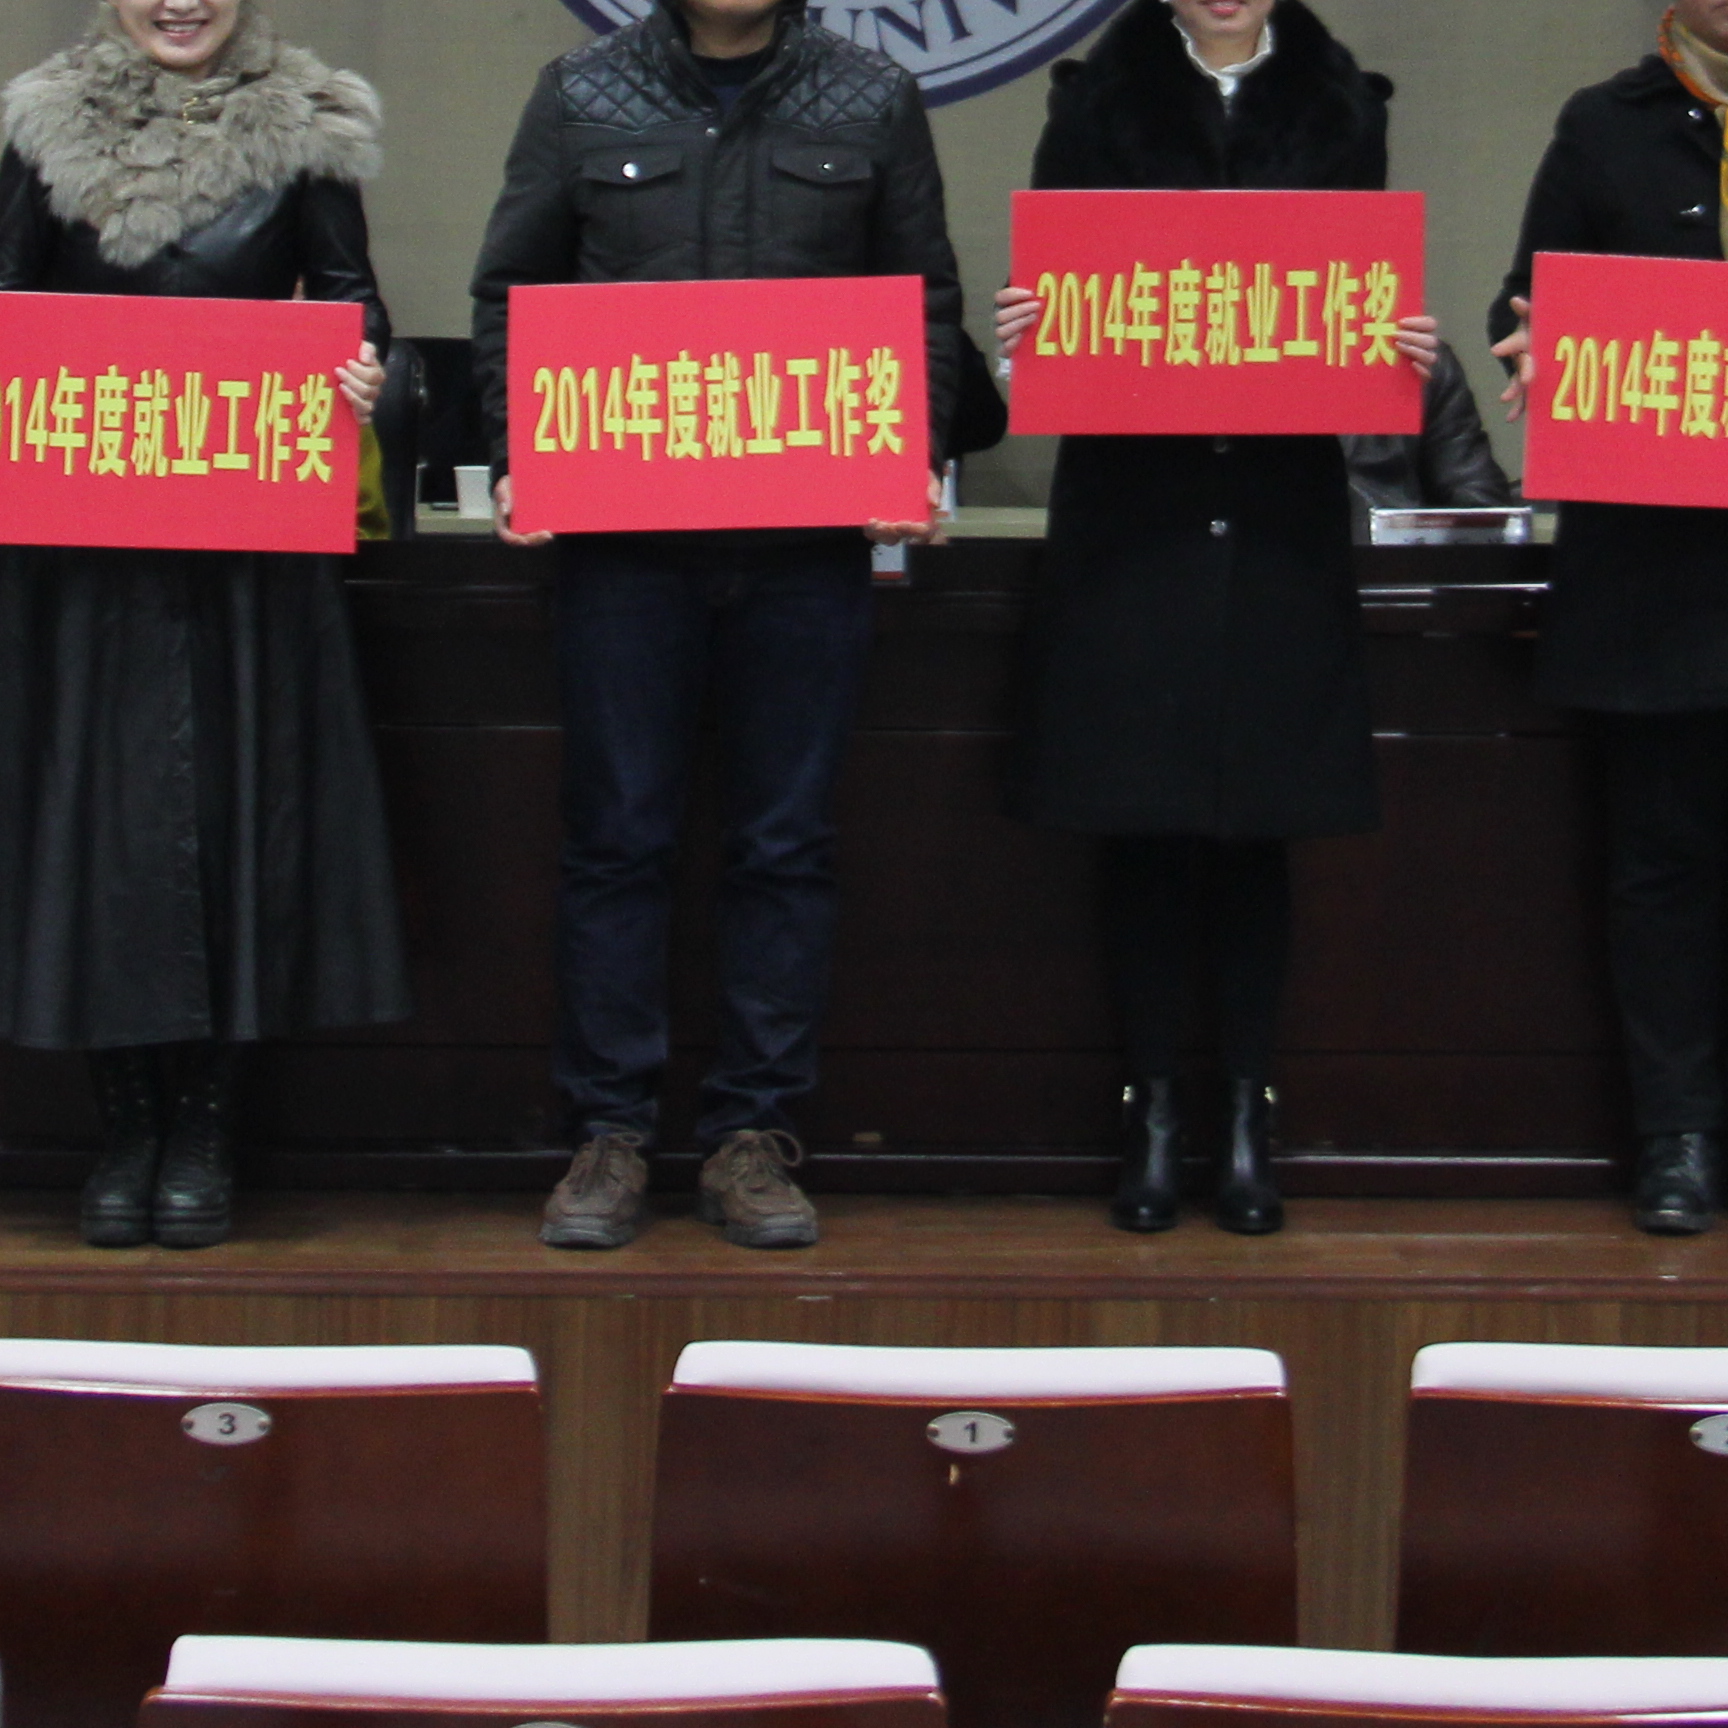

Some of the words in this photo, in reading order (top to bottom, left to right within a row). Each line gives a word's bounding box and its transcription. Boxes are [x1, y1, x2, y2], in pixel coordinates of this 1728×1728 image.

[1035, 258, 1399, 367] 2014年度就业工作奖
[534, 346, 904, 461] 2014年度就业工作奖
[218, 1412, 238, 1435] 3
[964, 1421, 978, 1443] 1
